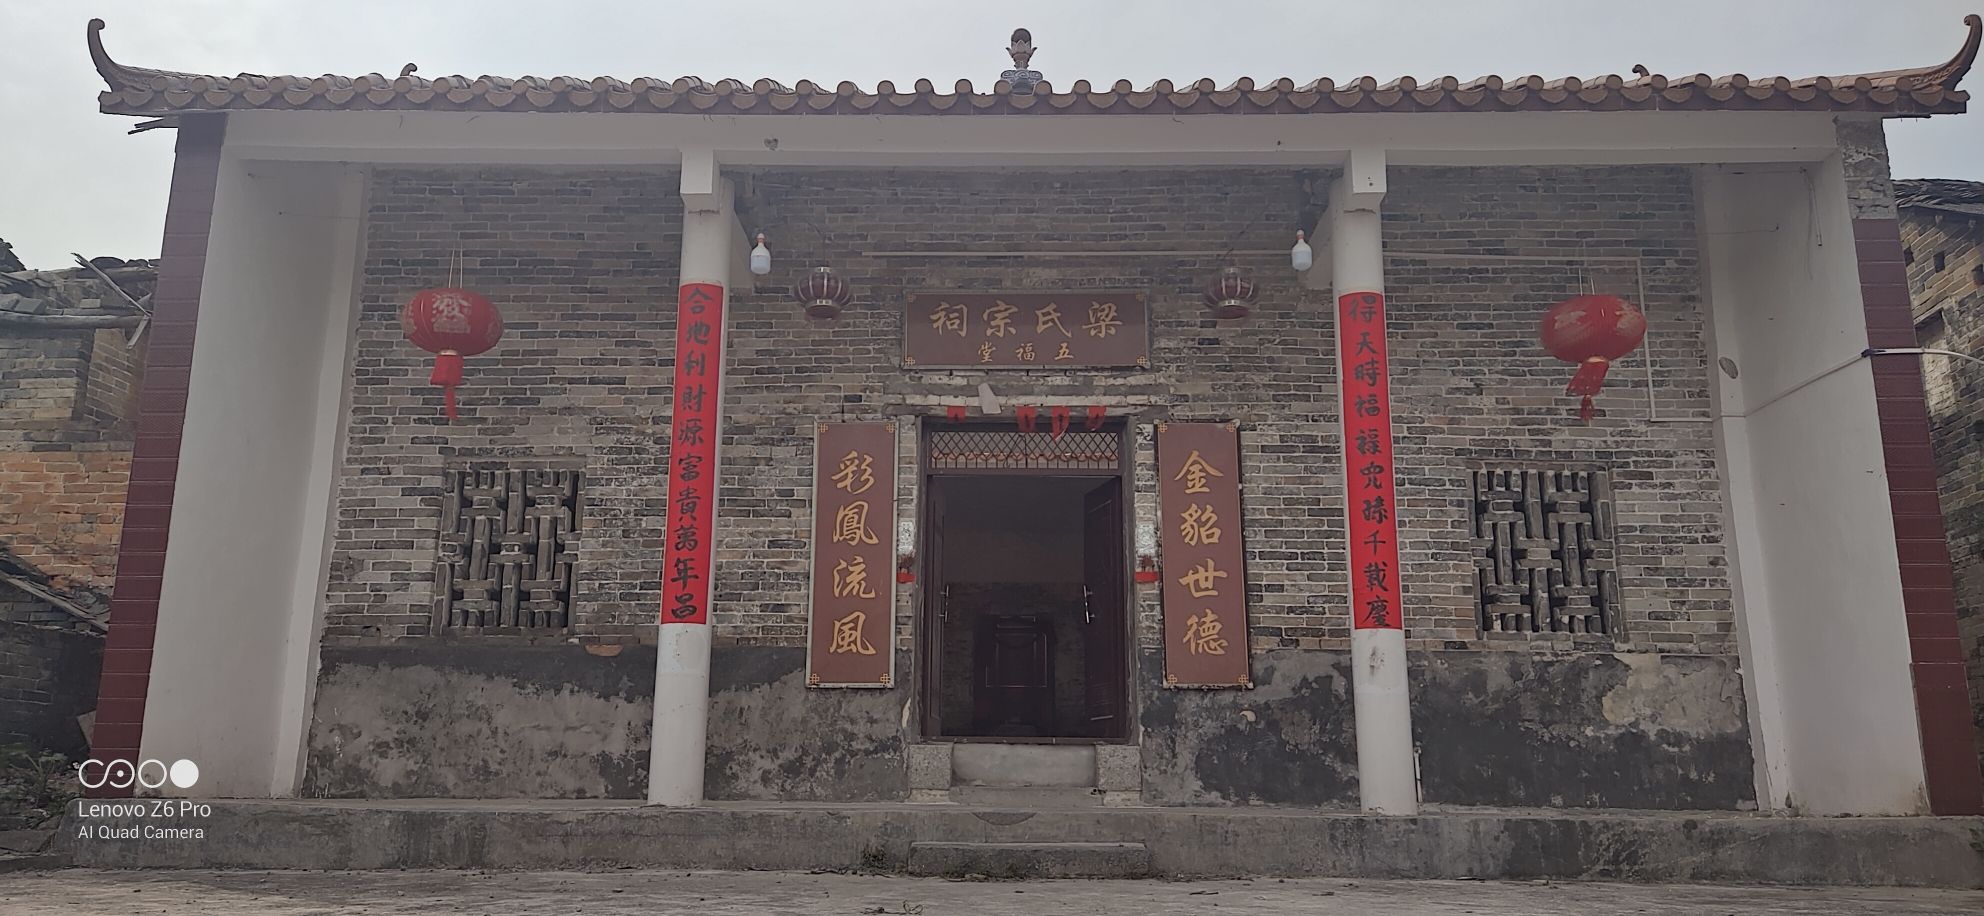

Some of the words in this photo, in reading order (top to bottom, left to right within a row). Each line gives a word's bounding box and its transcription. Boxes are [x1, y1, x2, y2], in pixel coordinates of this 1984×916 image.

[929, 300, 1123, 338] 梁氏宗祠
[977, 341, 1075, 363] 五福堂
[670, 287, 712, 620] 合地利財源富貴萬年昌
[829, 449, 879, 656] 彩鳳流風
[1174, 449, 1230, 656] 金貂世德
